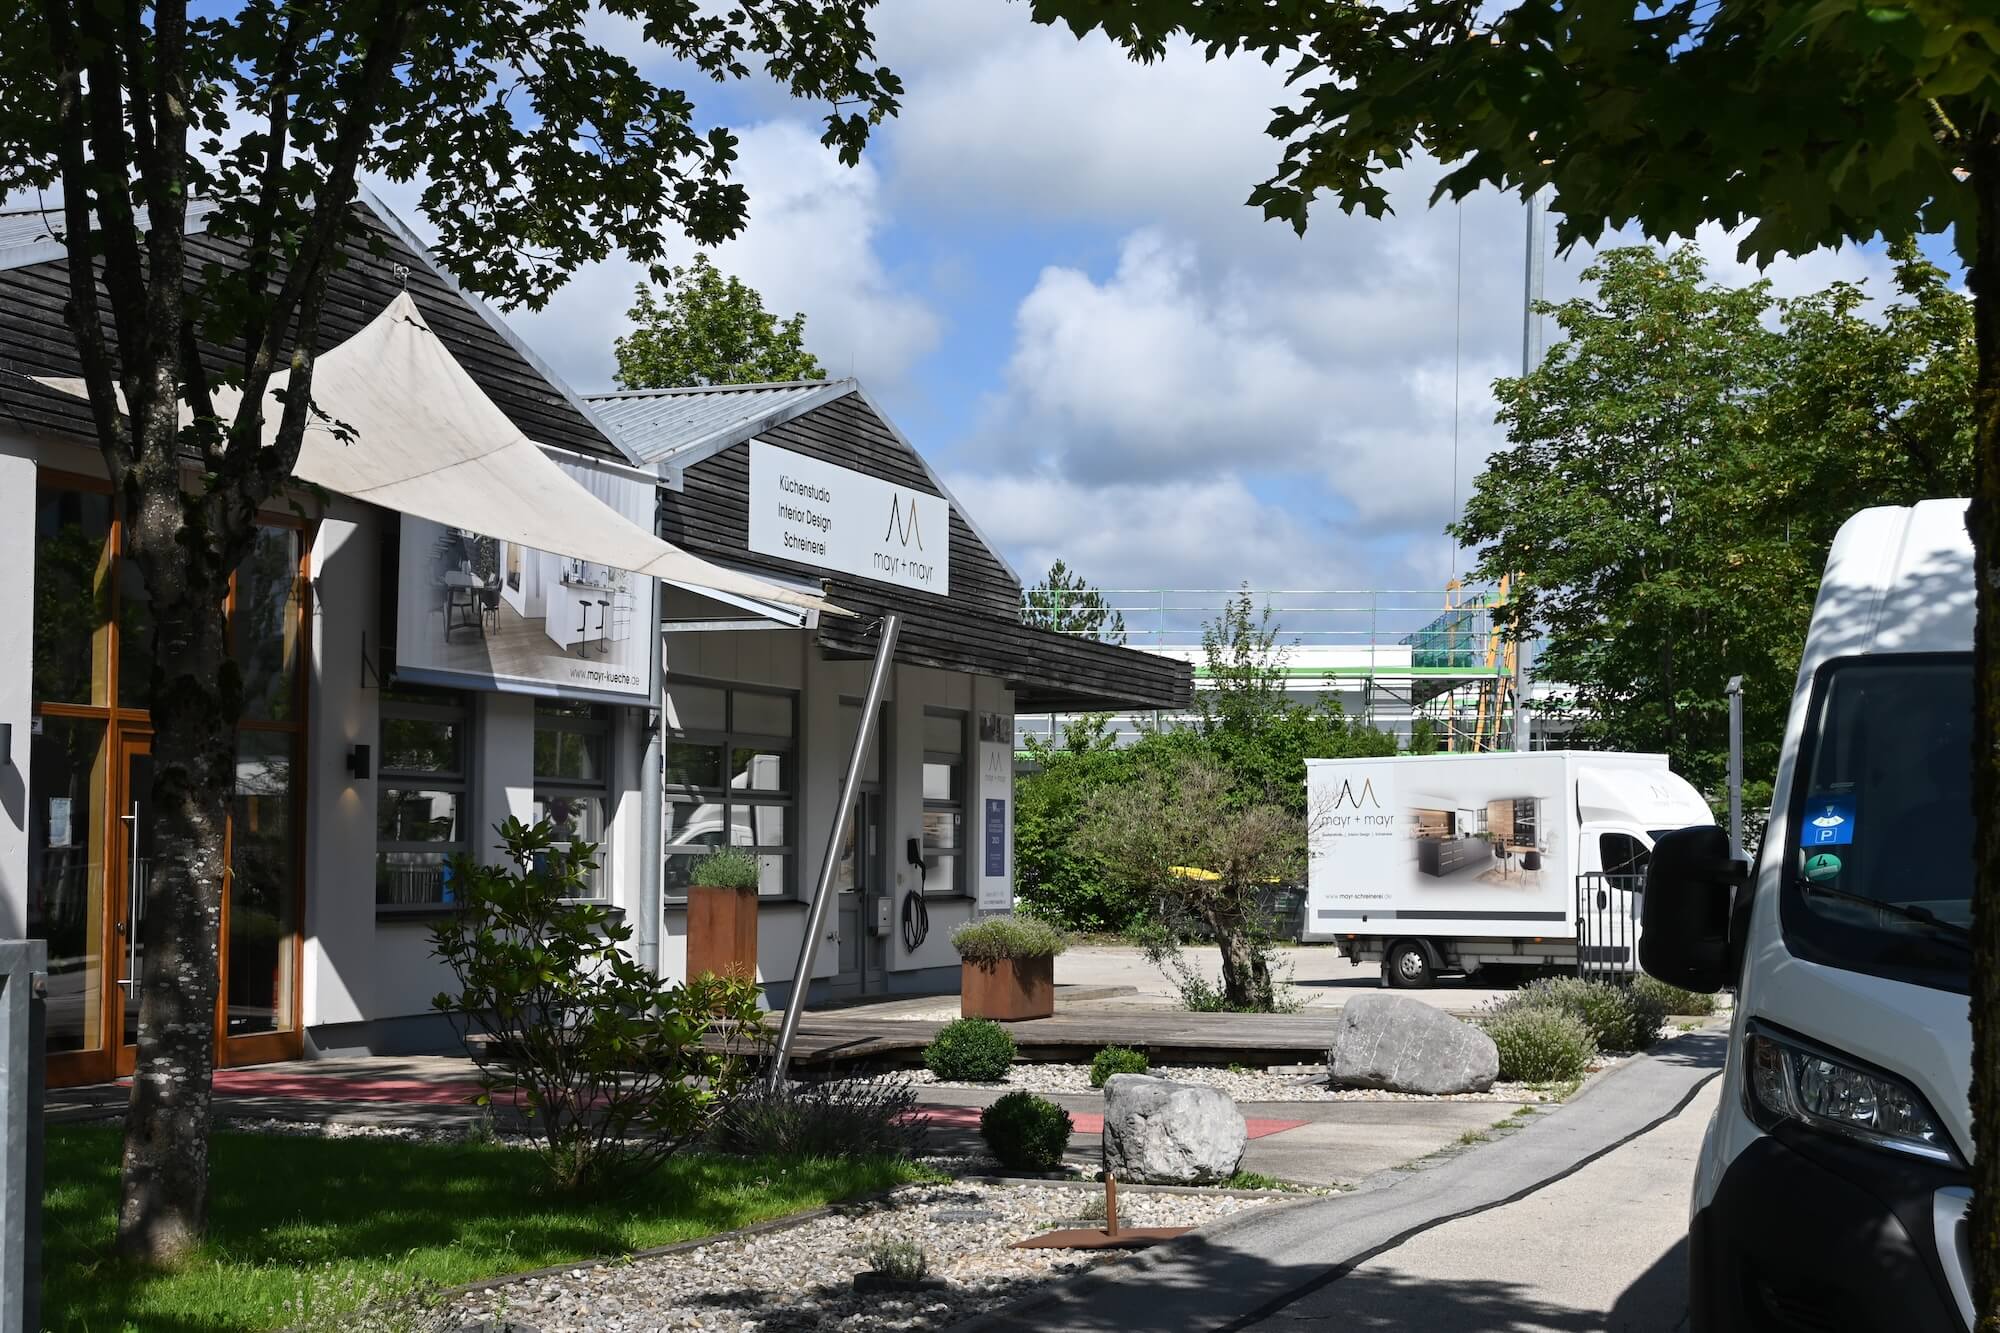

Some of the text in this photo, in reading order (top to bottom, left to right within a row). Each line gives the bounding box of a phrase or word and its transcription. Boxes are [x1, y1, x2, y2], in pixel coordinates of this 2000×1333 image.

[779, 474, 831, 503] Küchenstudio
[778, 501, 832, 533] Interior Design
[783, 531, 826, 556] Schreinerei
[873, 552, 899, 577] mayr
[909, 561, 933, 584] mayr
[1321, 815, 1351, 829] mayr
[1364, 815, 1394, 829] mayr
[1821, 830, 1832, 840] P
[1817, 855, 1827, 867] 4
